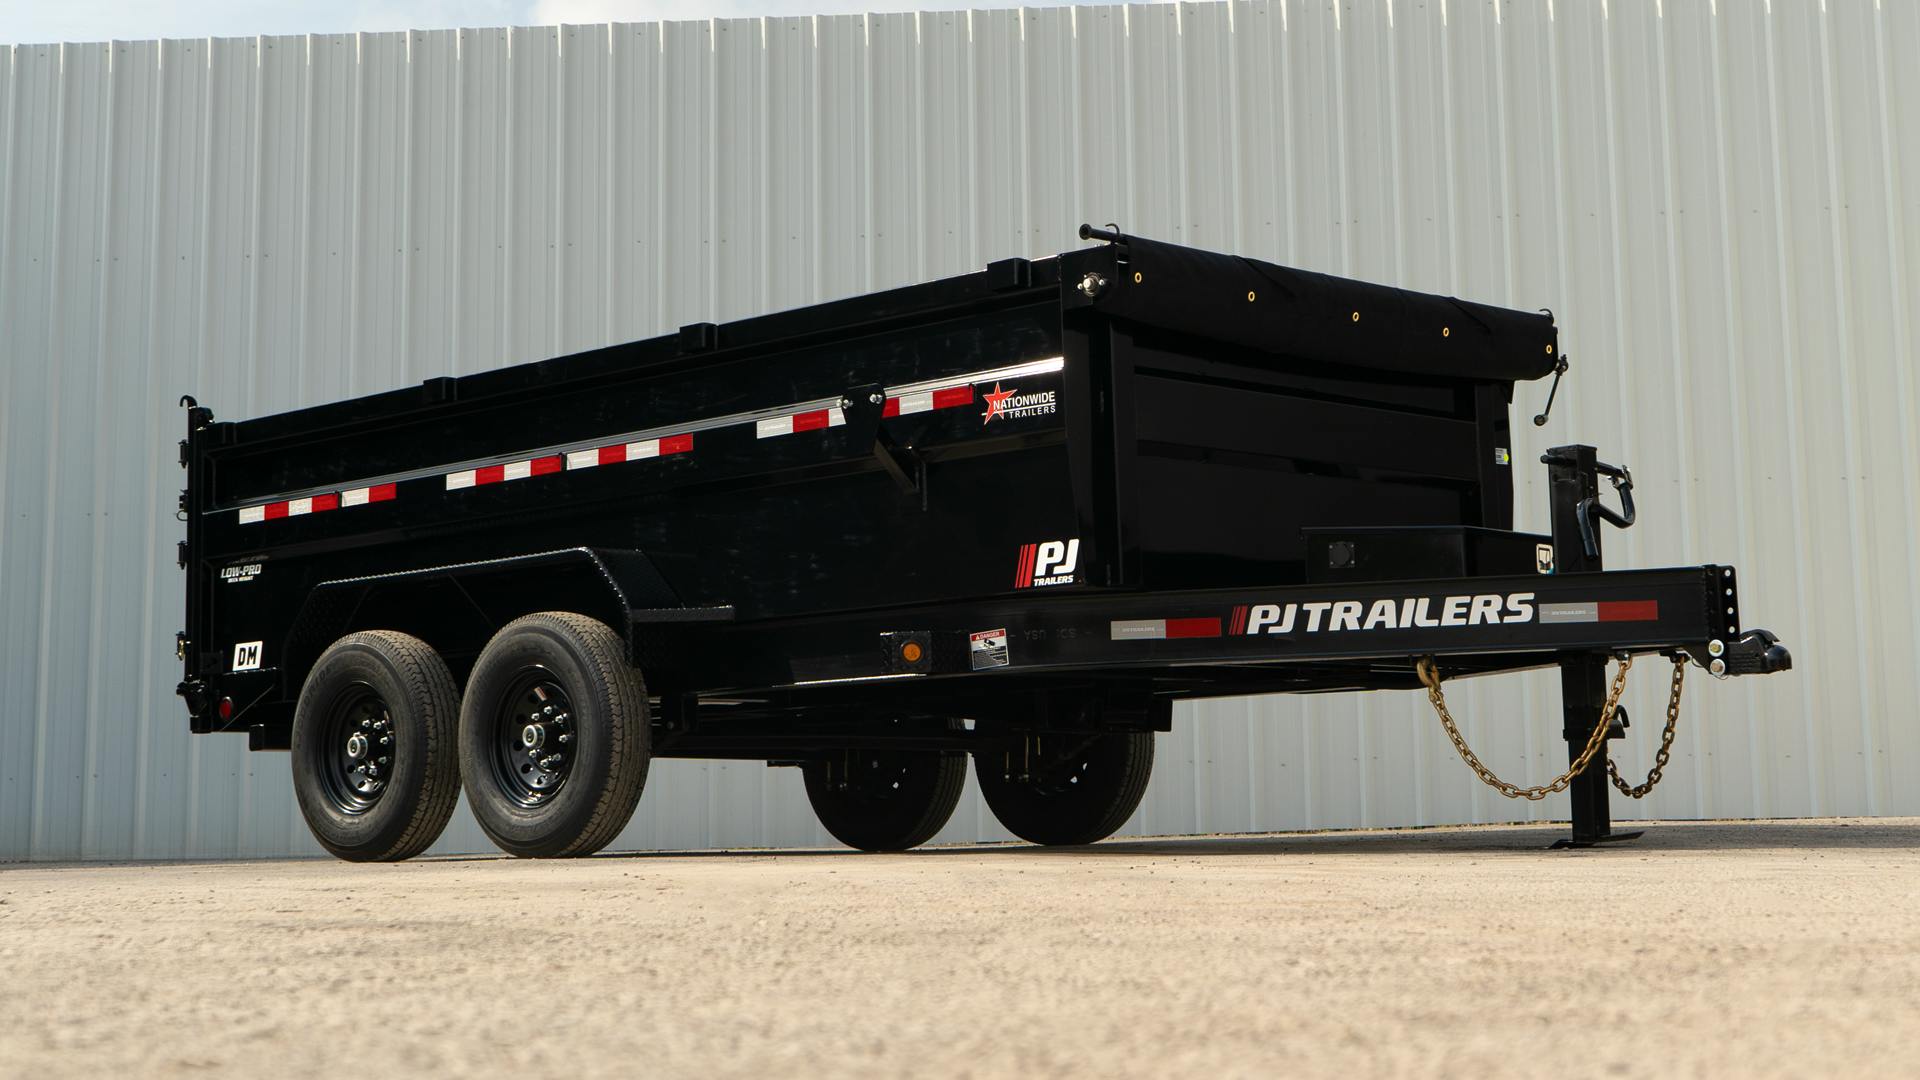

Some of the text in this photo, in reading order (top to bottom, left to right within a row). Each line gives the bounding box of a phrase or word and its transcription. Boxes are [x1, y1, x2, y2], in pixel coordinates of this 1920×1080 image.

[993, 391, 1056, 411] NATIONWIDE
[1009, 405, 1056, 419] TRAILERS
[1034, 538, 1080, 577] PJ
[220, 563, 262, 579] LOW-PRO
[1033, 574, 1074, 587] TRAILERS
[1247, 592, 1535, 635] PJ TRAILERS
[237, 645, 258, 667] DM
